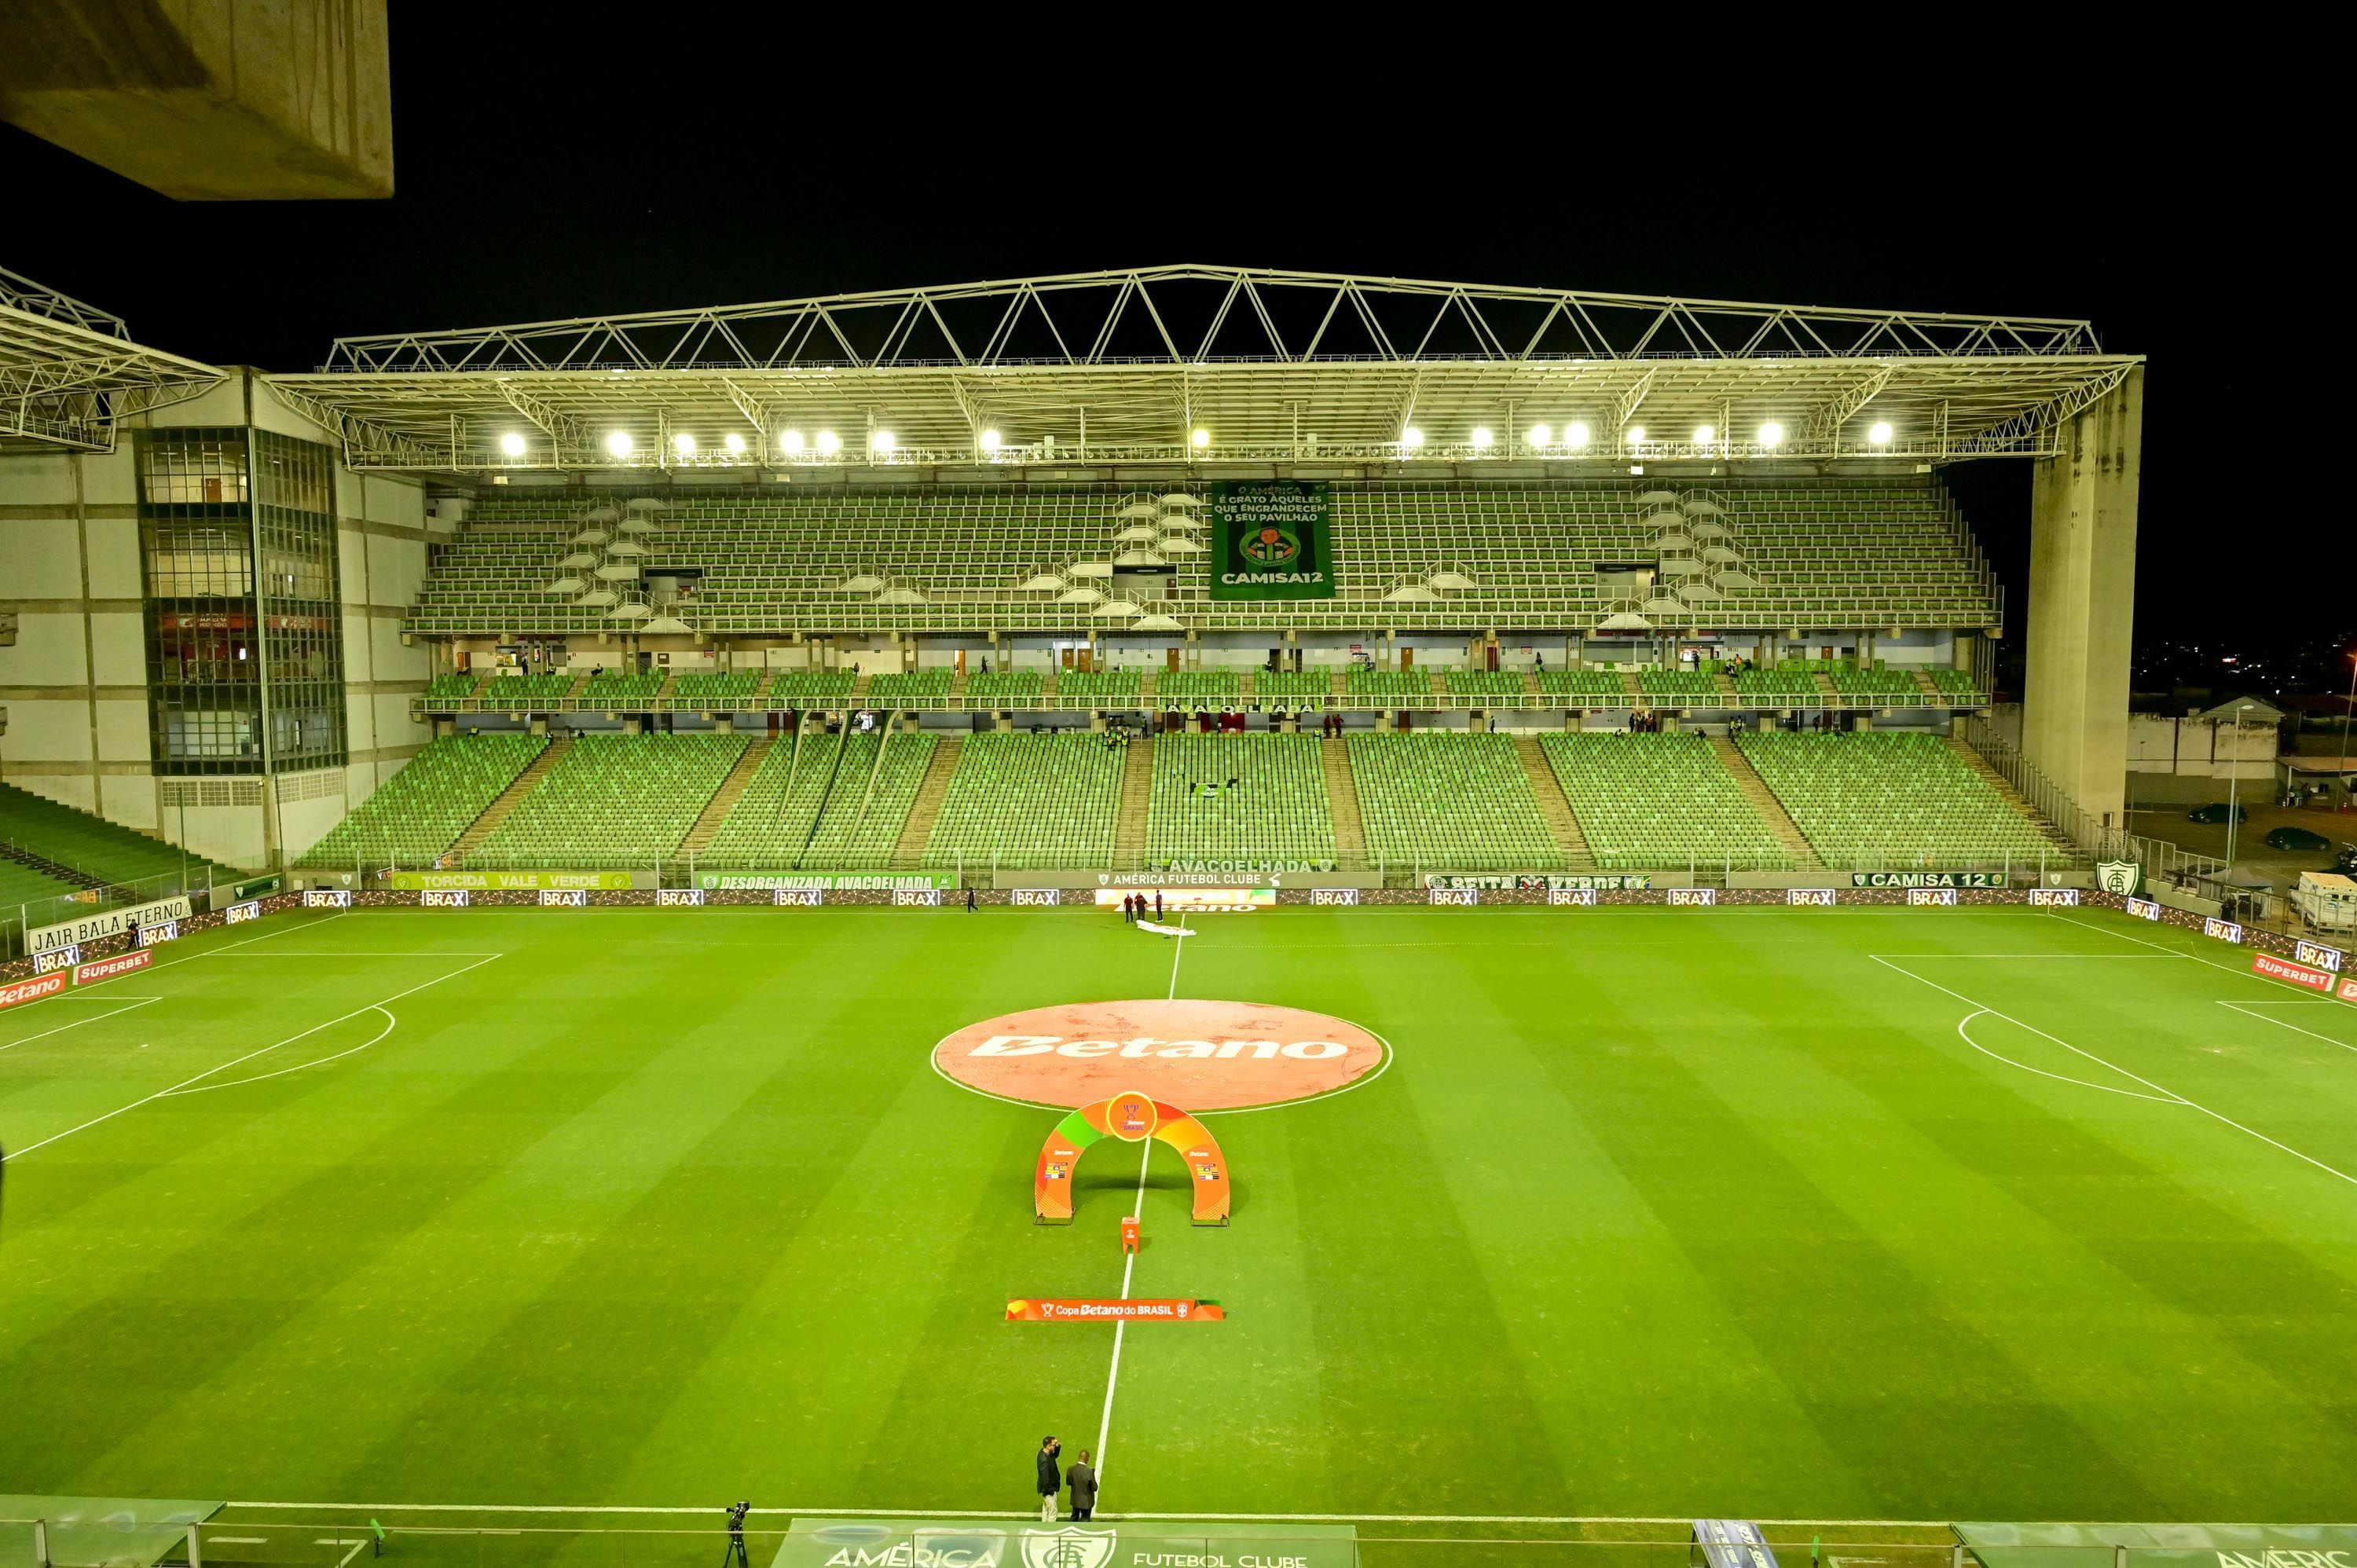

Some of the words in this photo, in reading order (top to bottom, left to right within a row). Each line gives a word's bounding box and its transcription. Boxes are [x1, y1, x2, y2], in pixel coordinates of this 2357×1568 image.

[1237, 485, 1247, 494] O
[1249, 485, 1303, 495] AMÉRICA
[1219, 494, 1226, 504] É
[1228, 495, 1267, 504] GRATO
[1269, 493, 1322, 505] ÀQUELES
[1214, 505, 1237, 515] QUE
[1240, 504, 1328, 513] ENGRANDECEM
[1223, 514, 1233, 522] O
[1235, 513, 1257, 522] SEU
[1259, 512, 1318, 522] PAVILHÃO
[1221, 572, 1325, 584] CAMISA12
[1167, 705, 1314, 713] AVACOELHADA
[1169, 859, 1313, 872] AVACOELHADA
[421, 874, 488, 888] TORCIDA
[499, 874, 538, 888] VALE
[549, 874, 600, 888] VERDE
[720, 876, 834, 890] DESORGANIZADA
[834, 876, 933, 890] AVACOELHADA
[1113, 872, 1165, 885] AMÉRICA
[1168, 874, 1221, 885] FUTEBOL
[1223, 874, 1261, 885] CLUBE
[1871, 874, 1955, 886] CAMISA
[1961, 874, 1986, 886] 12
[308, 893, 346, 907] BRAX
[425, 892, 464, 906] BRAX
[543, 892, 582, 906] BRAX
[661, 892, 700, 906] BRAX
[779, 892, 818, 906] BRAX
[897, 892, 936, 906] BRAX
[1016, 892, 1055, 906] BRAX
[1315, 892, 1354, 905] BRAX
[1434, 892, 1473, 905] BRAX
[1553, 892, 1592, 905] BRAX
[1673, 892, 1711, 905] BRAX
[1792, 892, 1831, 905] BRAX
[1913, 892, 1952, 905] BRAX
[2033, 892, 2074, 906] BRAX
[229, 905, 257, 924] BRAX
[2129, 901, 2157, 921] BRAX
[35, 928, 73, 951] JAIR
[79, 916, 120, 940] BALA
[125, 901, 183, 929] ETERNO
[2207, 921, 2239, 943] BRAX
[141, 924, 175, 947] BRAX
[39, 946, 77, 973] BRAX
[80, 952, 150, 979] SUPERBET
[2300, 946, 2337, 971] BRAX
[2256, 958, 2327, 985] SUPERBET
[967, 1035, 1348, 1059] Betano
[1055, 1305, 1080, 1317] Copa
[1080, 1304, 1124, 1316] Betano
[1124, 1305, 1137, 1315] do
[1137, 1305, 1173, 1316] BRASIL
[824, 1541, 998, 1568] AMÉRICA
[1133, 1552, 1233, 1568] FUTEBOL
[1238, 1555, 1308, 1568] CLUBE
